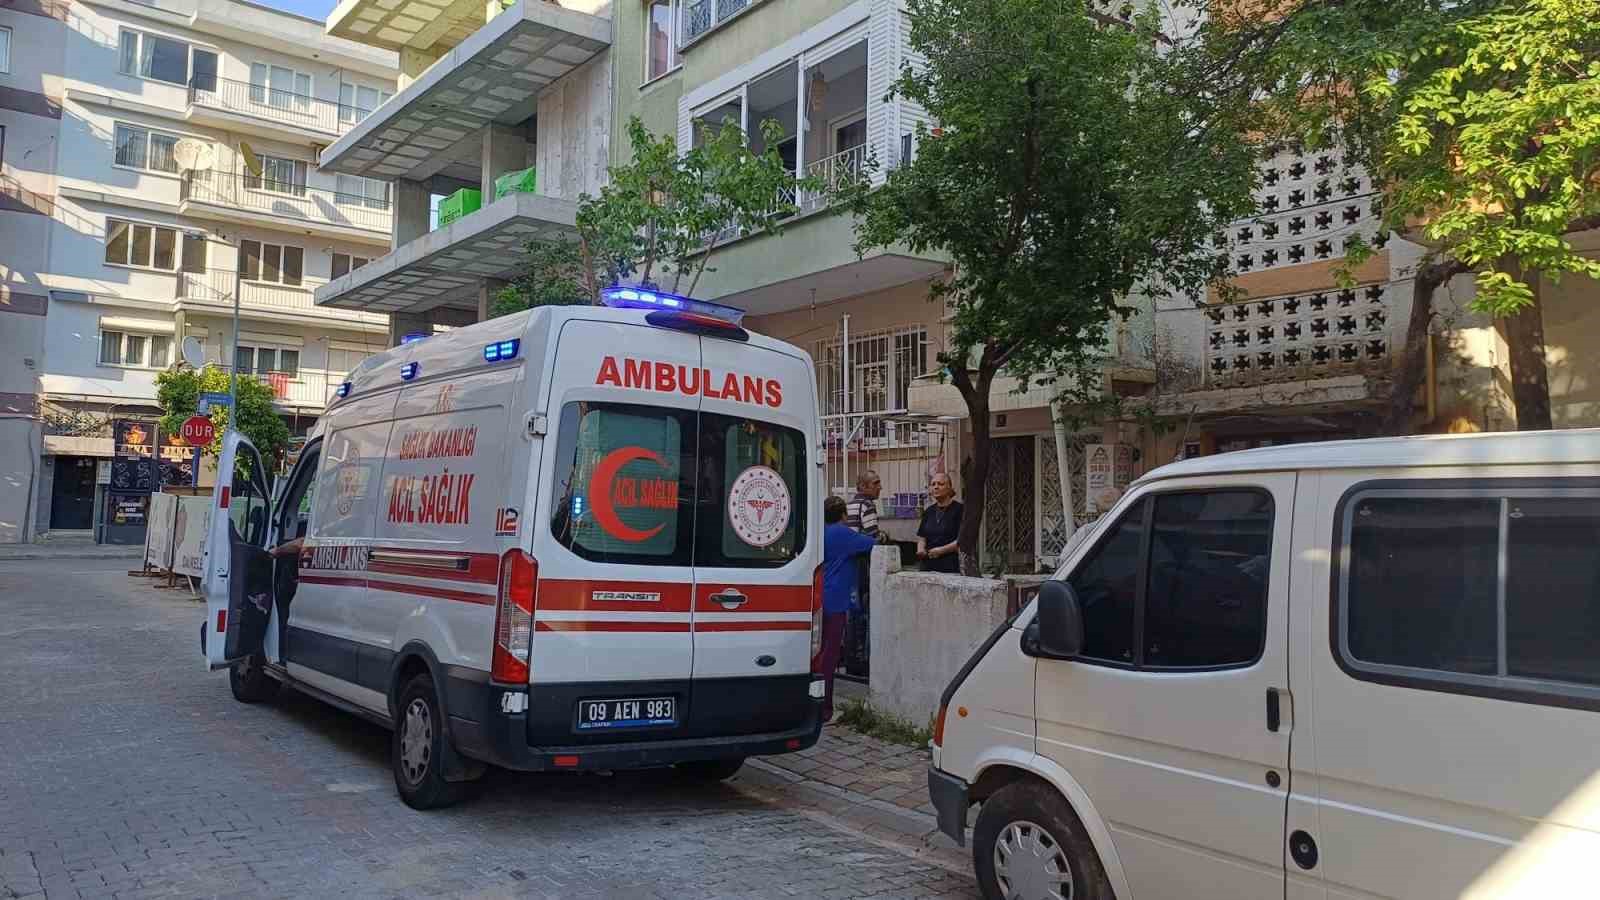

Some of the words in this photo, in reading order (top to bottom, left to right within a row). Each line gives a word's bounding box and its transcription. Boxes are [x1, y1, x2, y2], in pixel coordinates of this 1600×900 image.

[596, 356, 783, 408] AMBULANS
[185, 425, 213, 436] DUR
[418, 467, 474, 524] SAĞLIK
[496, 508, 518, 531] 112
[311, 546, 368, 570] AMBULANS
[594, 592, 658, 600] TRANSIT
[589, 703, 607, 721] 09
[614, 701, 640, 720] AEN
[647, 700, 672, 718] 983
